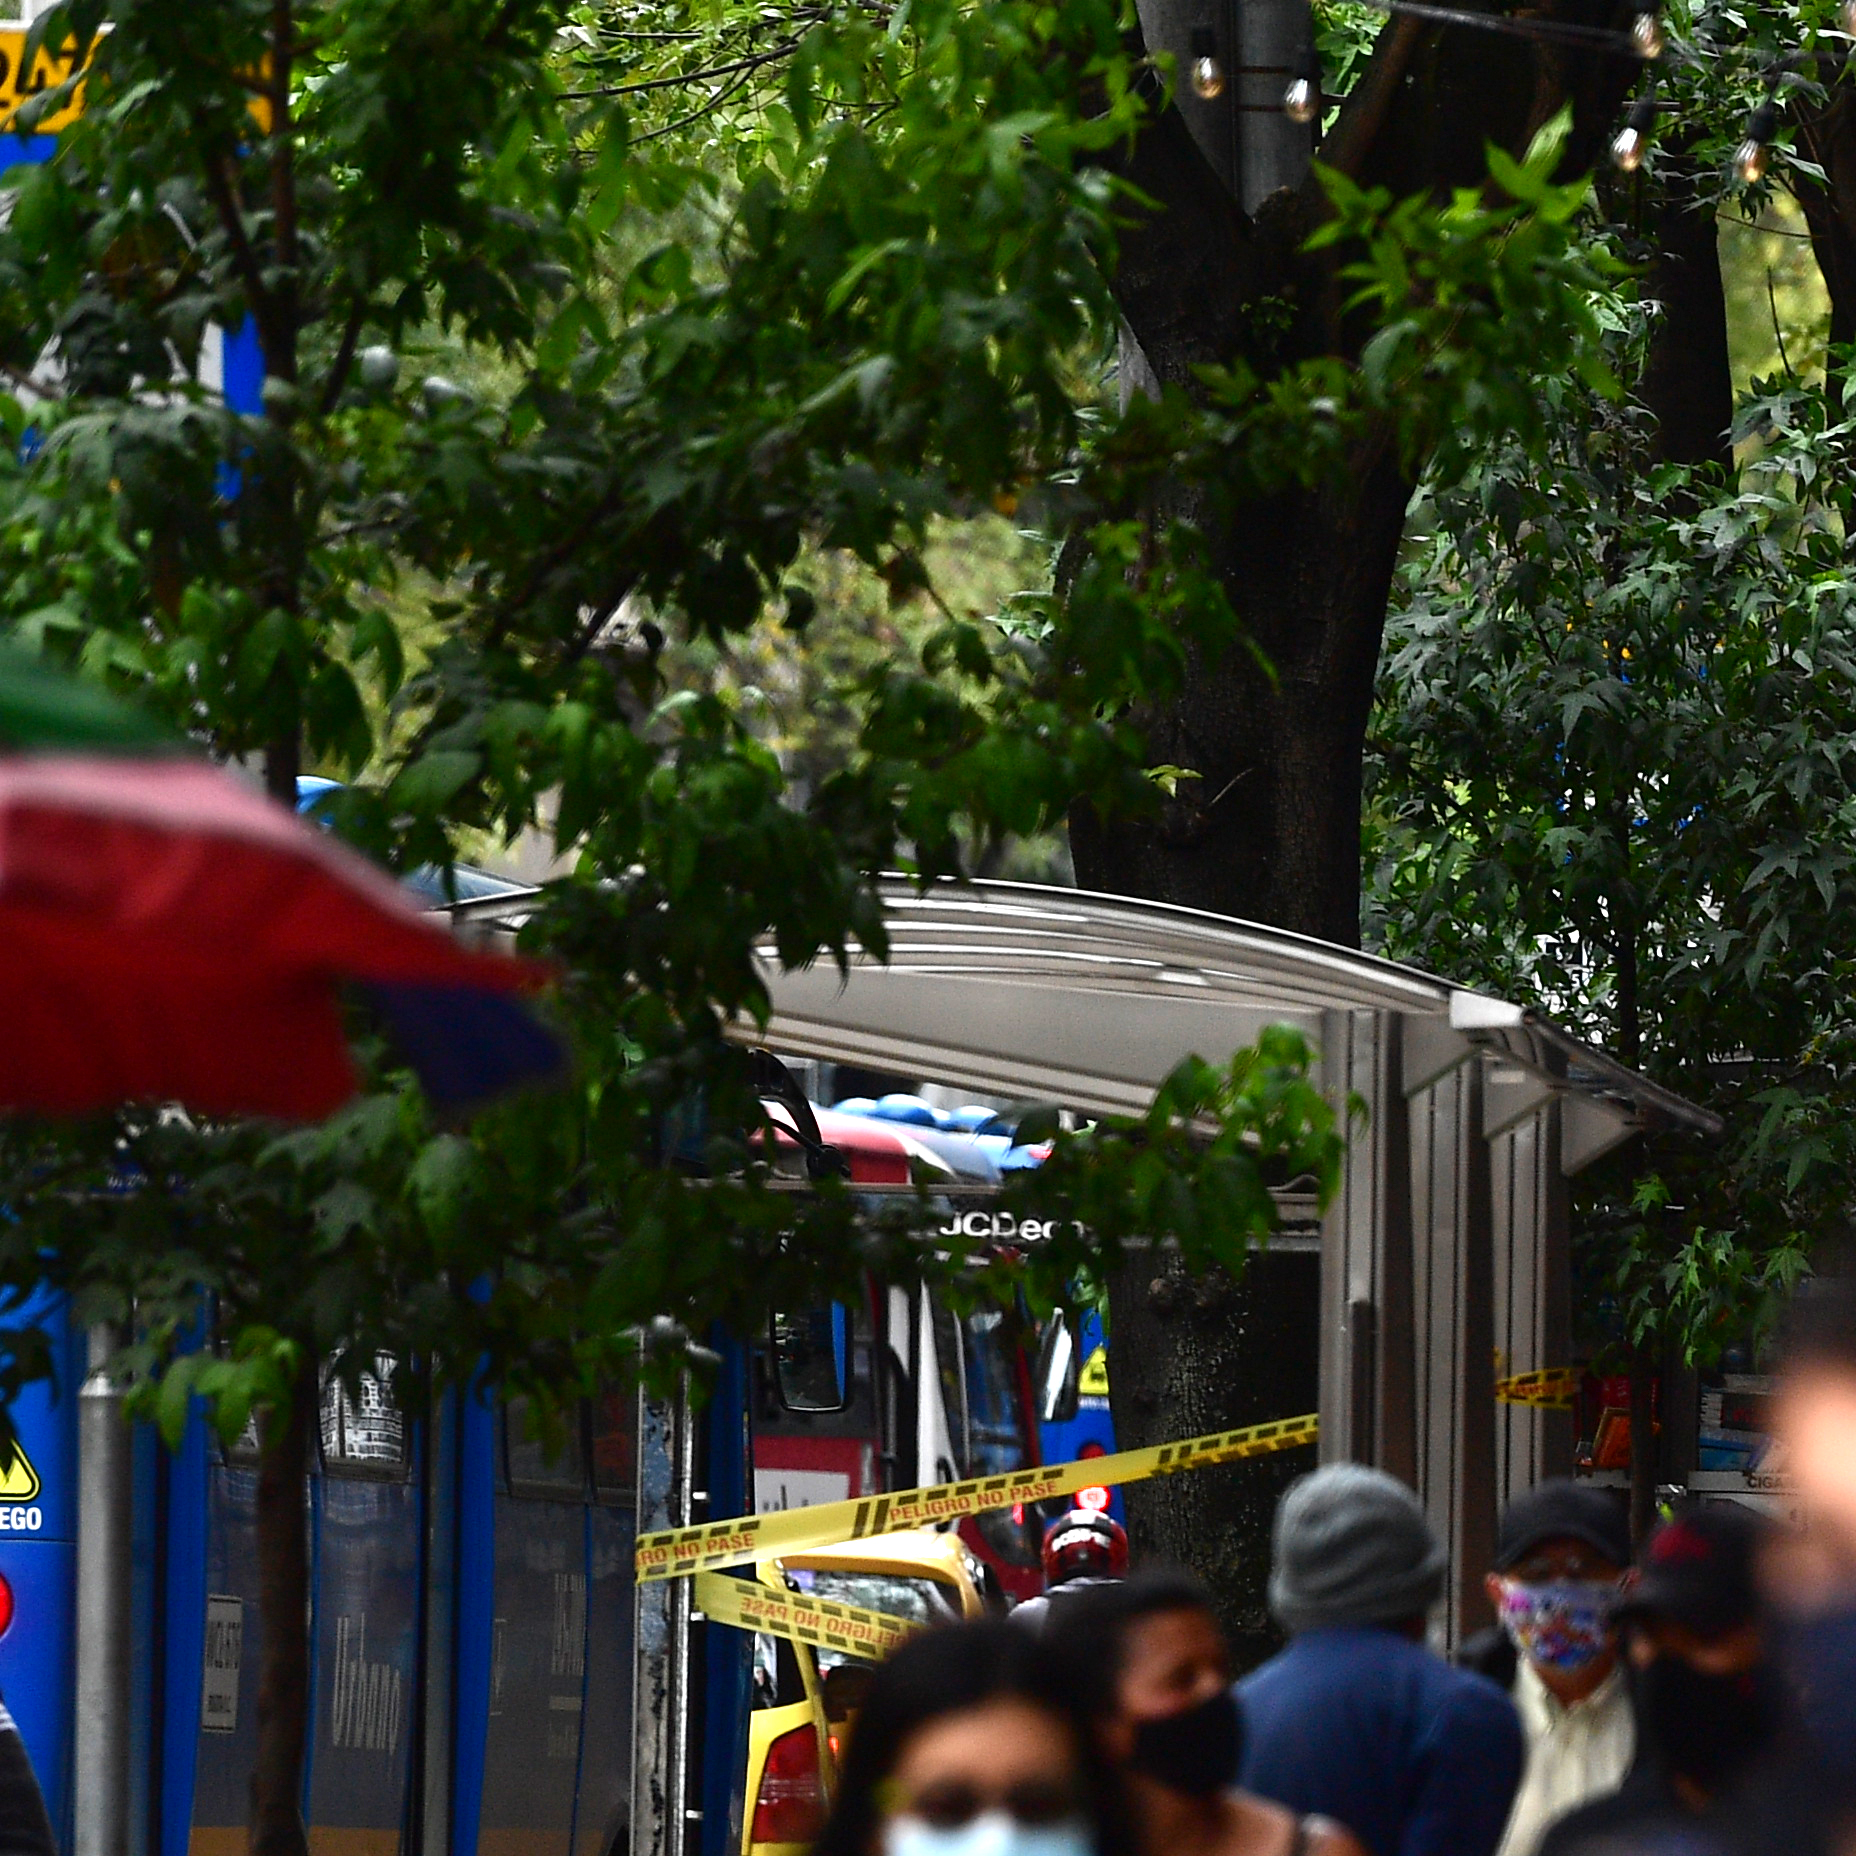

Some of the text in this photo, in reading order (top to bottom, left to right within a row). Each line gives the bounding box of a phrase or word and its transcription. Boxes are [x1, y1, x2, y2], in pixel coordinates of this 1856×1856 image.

[890, 1481, 1057, 1522] PELIGRO NO PASE
[673, 1541, 700, 1559] NO
[706, 1532, 755, 1553] PASE
